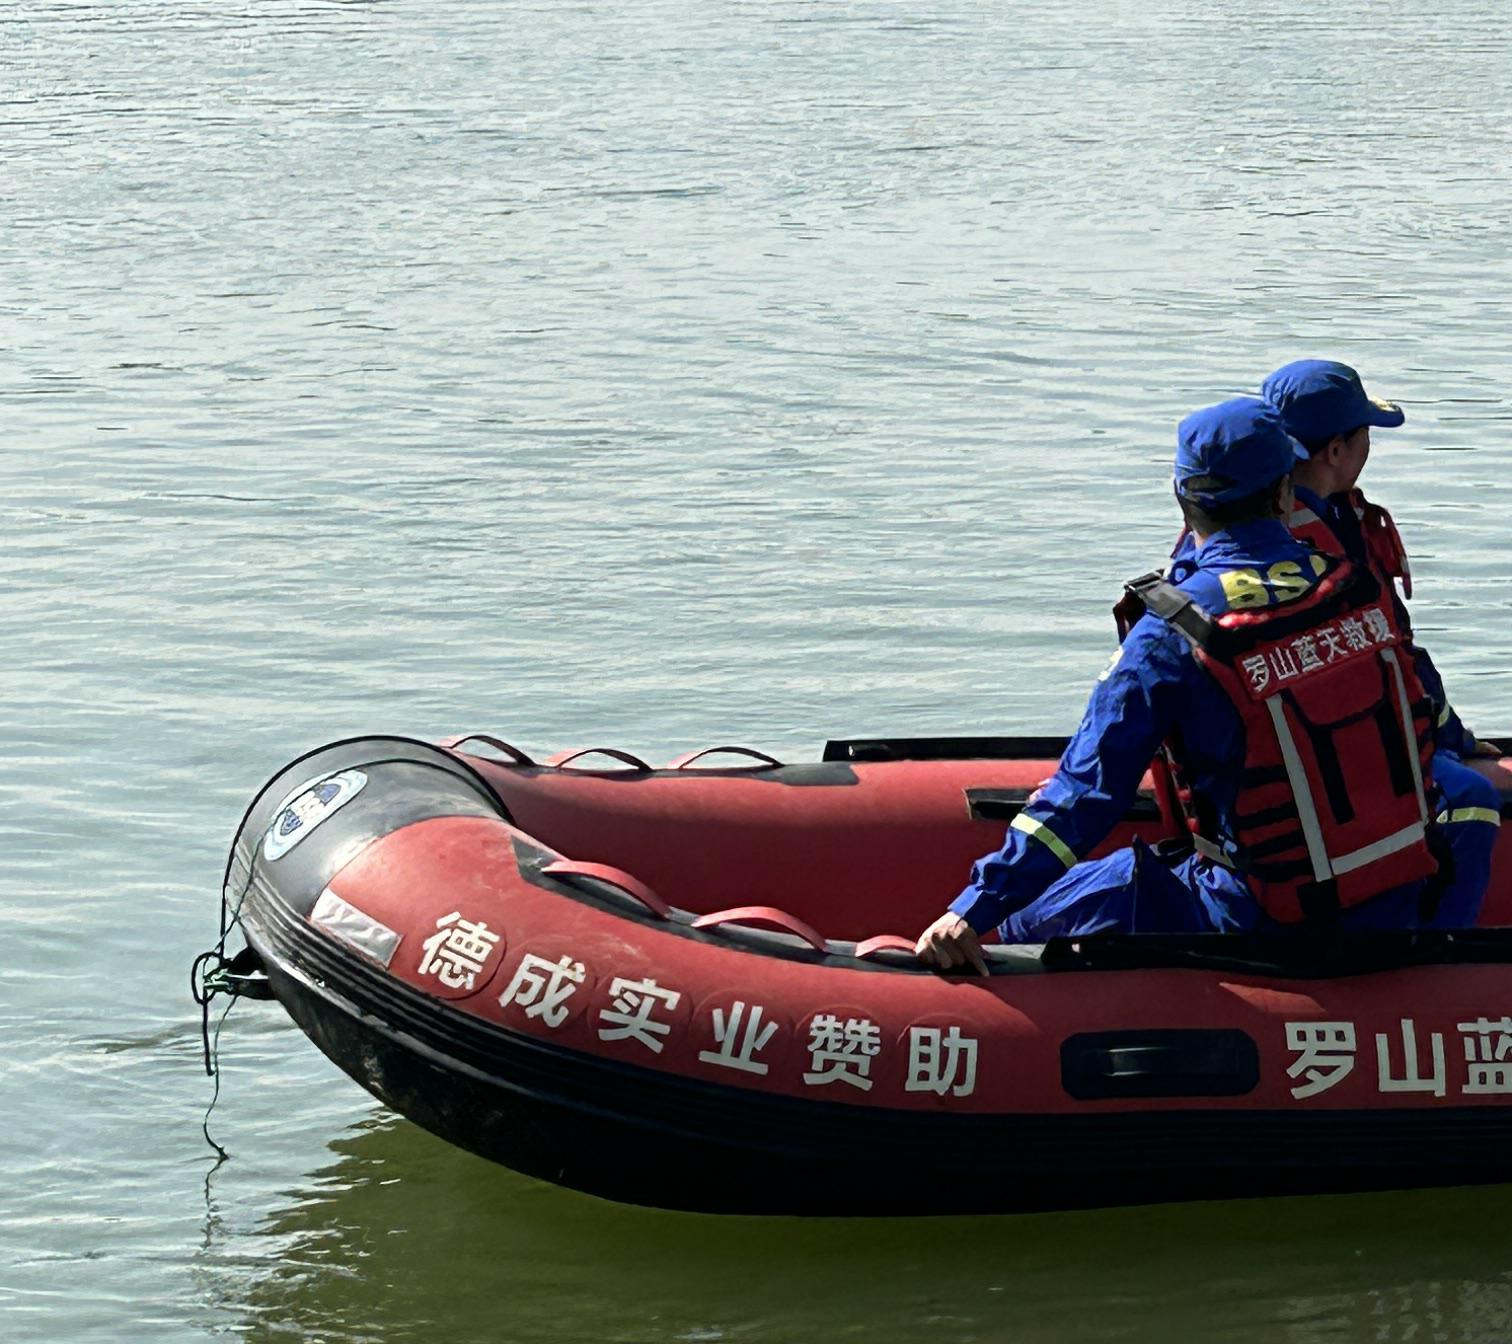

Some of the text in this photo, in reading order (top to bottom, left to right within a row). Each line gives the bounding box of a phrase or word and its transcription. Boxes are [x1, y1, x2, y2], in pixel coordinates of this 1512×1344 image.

[416, 910, 979, 1098] 德成实业赞助
